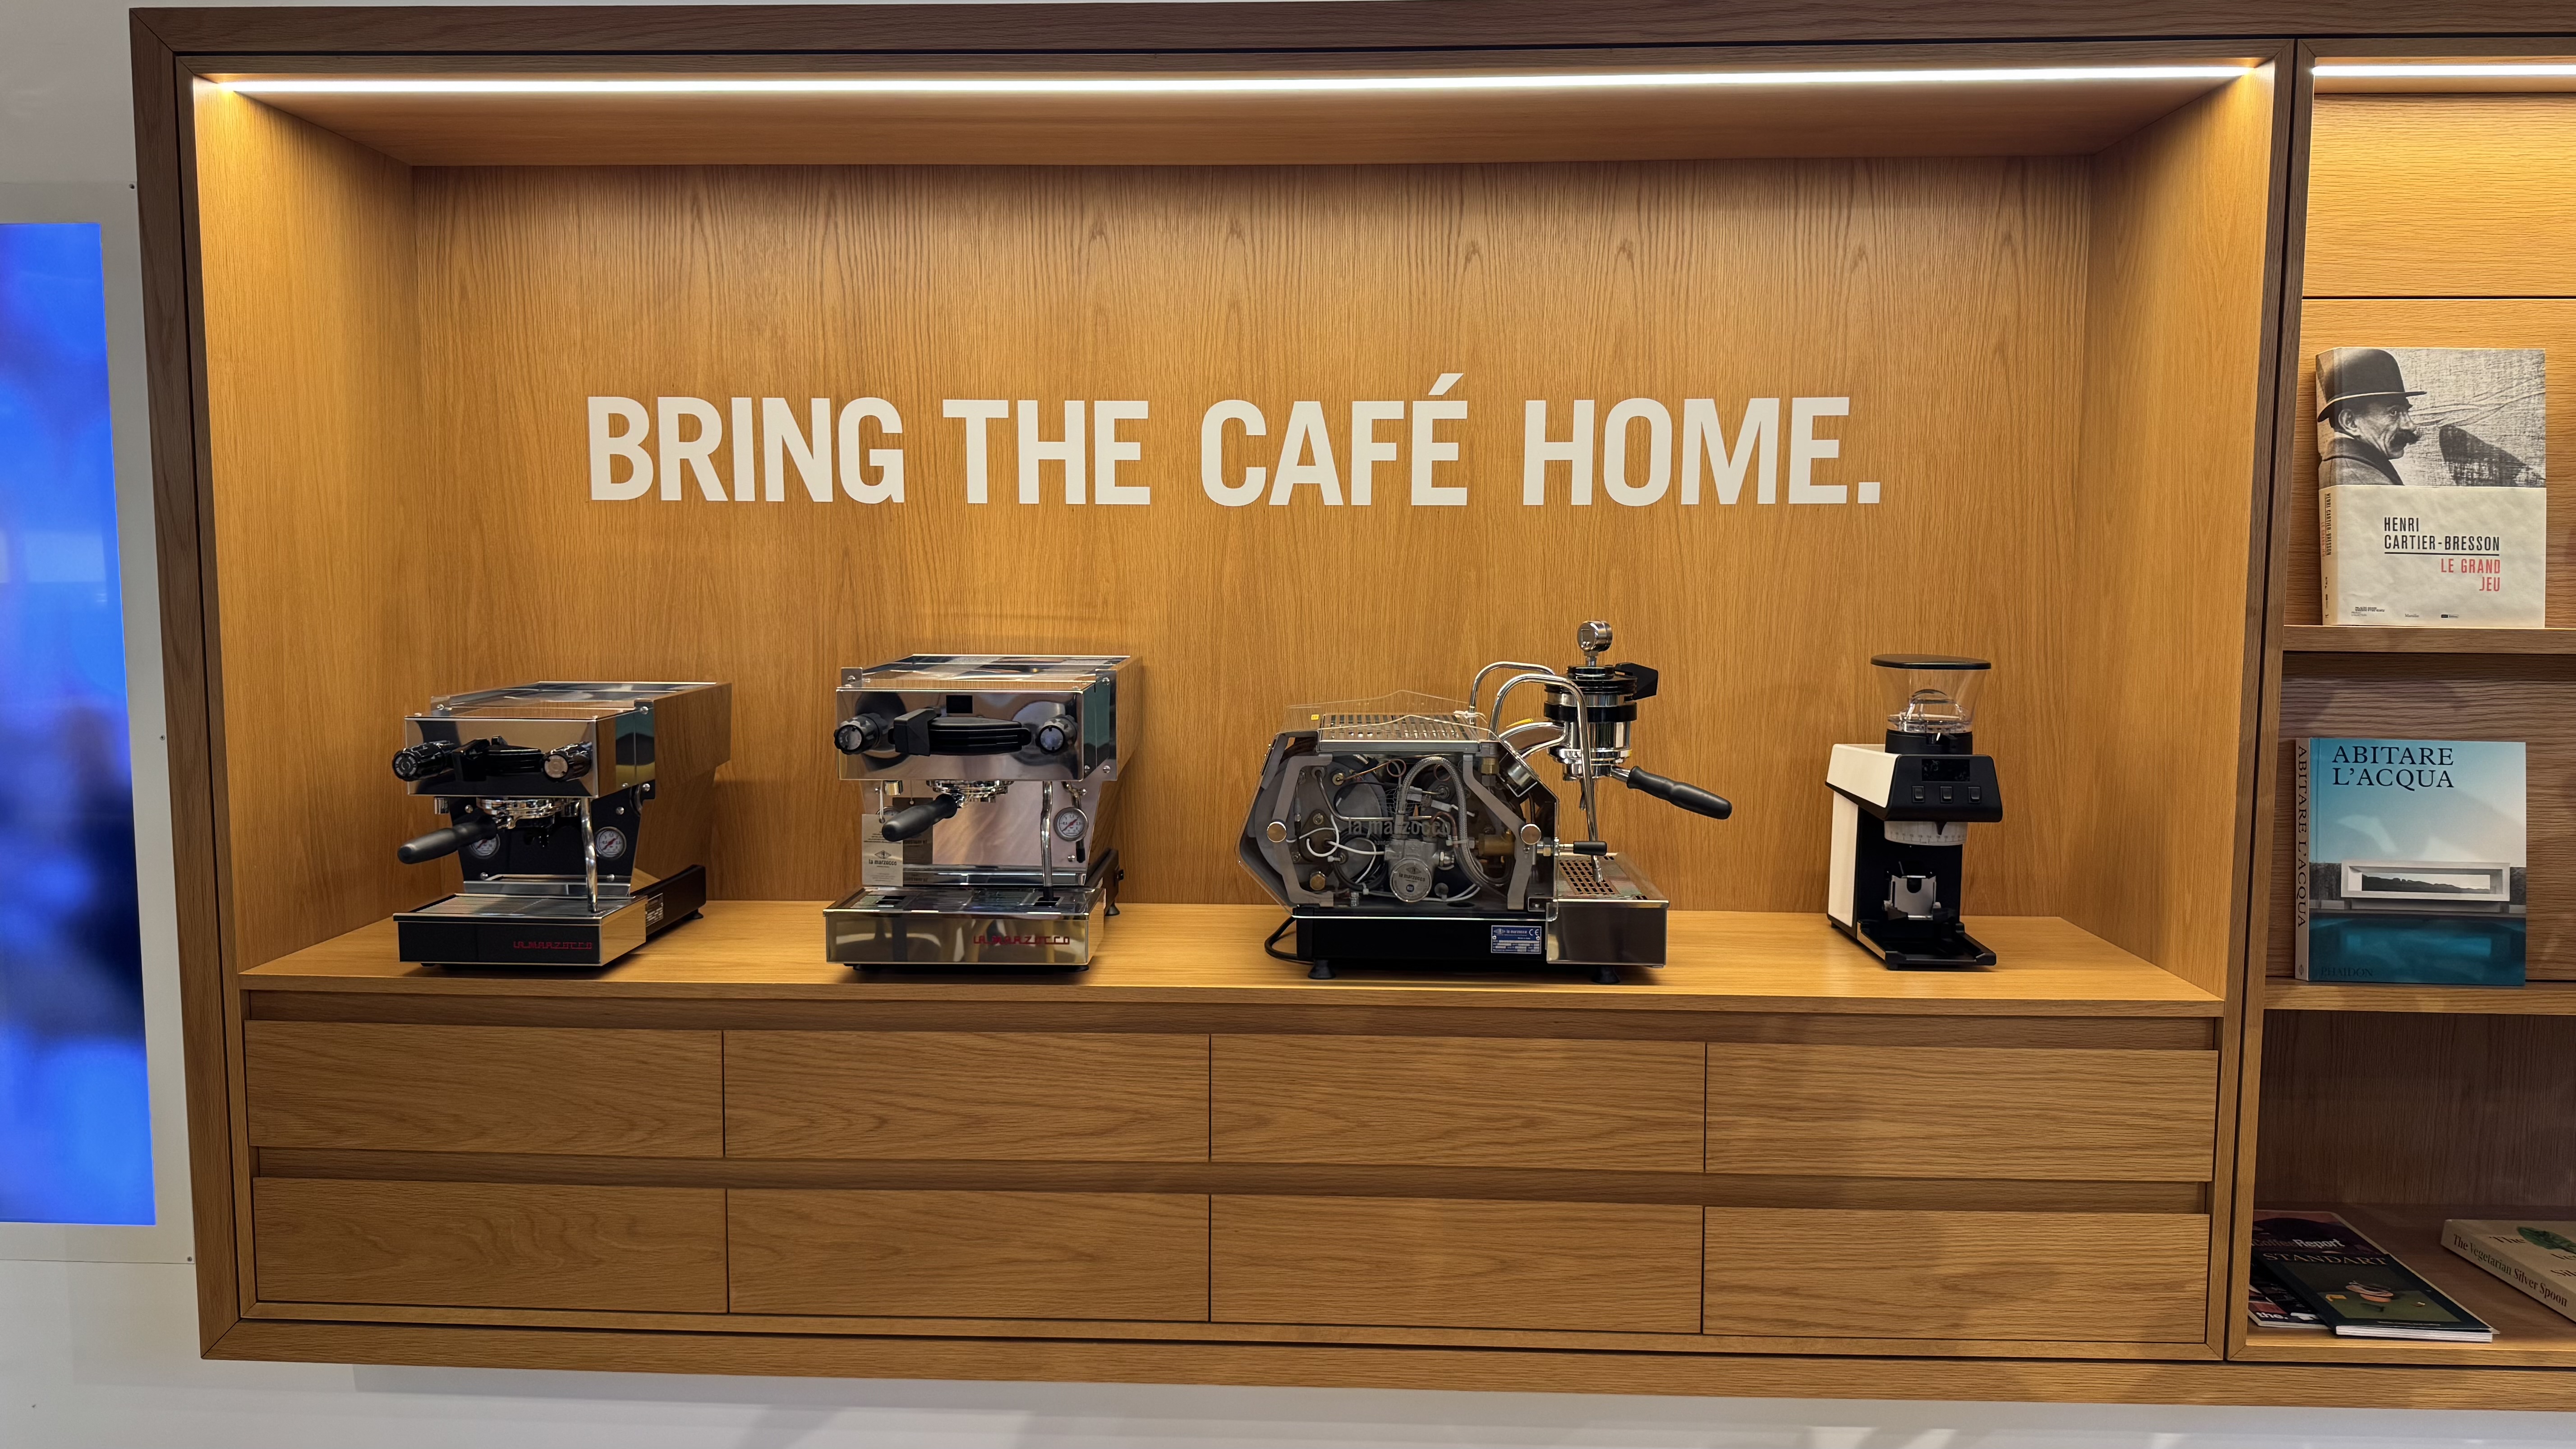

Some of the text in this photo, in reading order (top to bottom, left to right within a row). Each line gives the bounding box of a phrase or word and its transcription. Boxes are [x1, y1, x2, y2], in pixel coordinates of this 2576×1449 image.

[588, 373, 1880, 506] BRING THE CAFÉ HOME.
[2384, 517, 2419, 532] HENRI
[2384, 535, 2499, 551] CARTIER-BRESSON
[2441, 558, 2500, 574] LE GRAND
[2479, 577, 2500, 592] JEU
[2332, 745, 2454, 765] ABITARE
[2332, 768, 2454, 791] L'ACQUA
[1348, 818, 1362, 834] la
[2297, 746, 2307, 927] ABITARE L'ACQUA
[2321, 967, 2373, 977] PHAIDON
[2262, 1253, 2388, 1265] STANDART
[2453, 1233, 2568, 1307] The Vegetarian Silver Spoon
